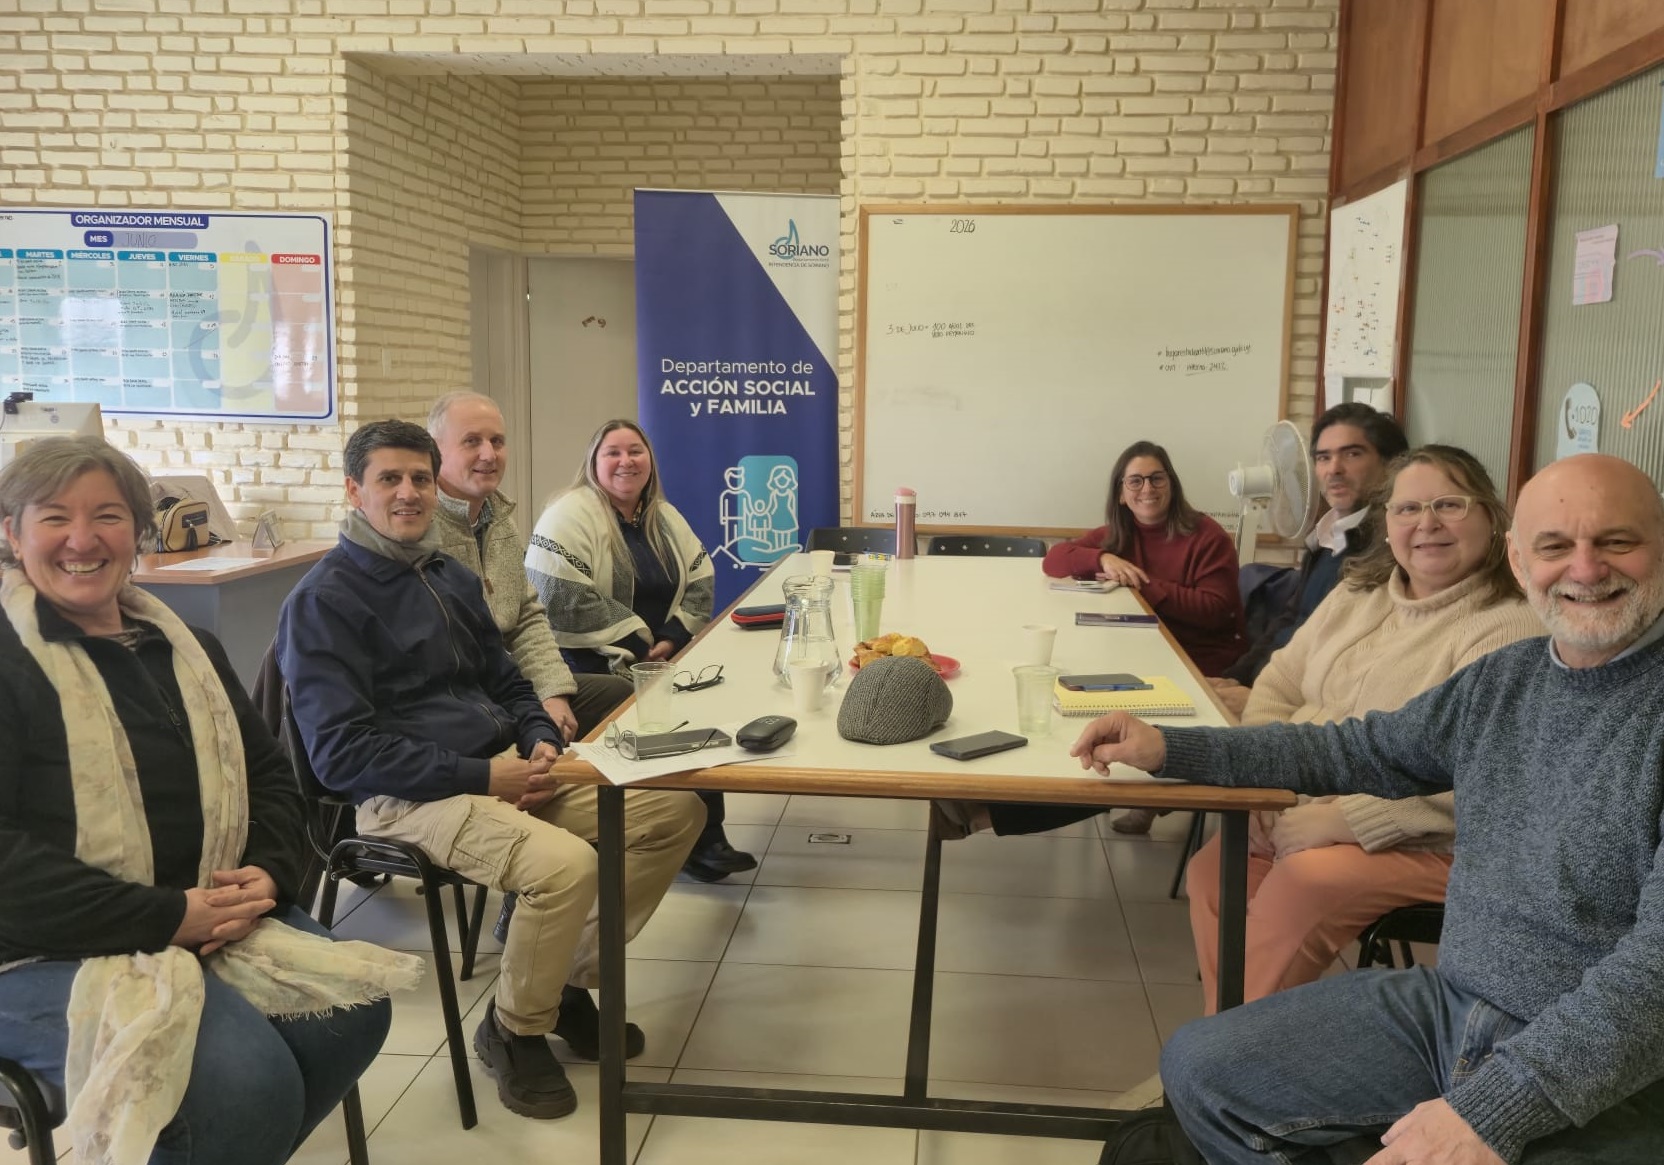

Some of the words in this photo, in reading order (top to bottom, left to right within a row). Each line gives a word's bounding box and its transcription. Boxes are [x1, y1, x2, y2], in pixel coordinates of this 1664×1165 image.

[75, 214, 151, 226] ORGANIZADOR
[154, 216, 205, 227] MENSUAL
[949, 218, 976, 234] 2026
[89, 235, 108, 243] MES
[122, 232, 157, 249] JUNIO
[25, 251, 55, 259] MARTES
[768, 243, 830, 257] SORIANO
[279, 256, 315, 264] DOMINGO
[661, 358, 787, 376] Departamento
[791, 360, 814, 375] de
[660, 376, 738, 395] ACCIÓN
[743, 380, 816, 396] SOCIAL
[690, 402, 702, 418] y
[707, 399, 788, 415] FAMILIA
